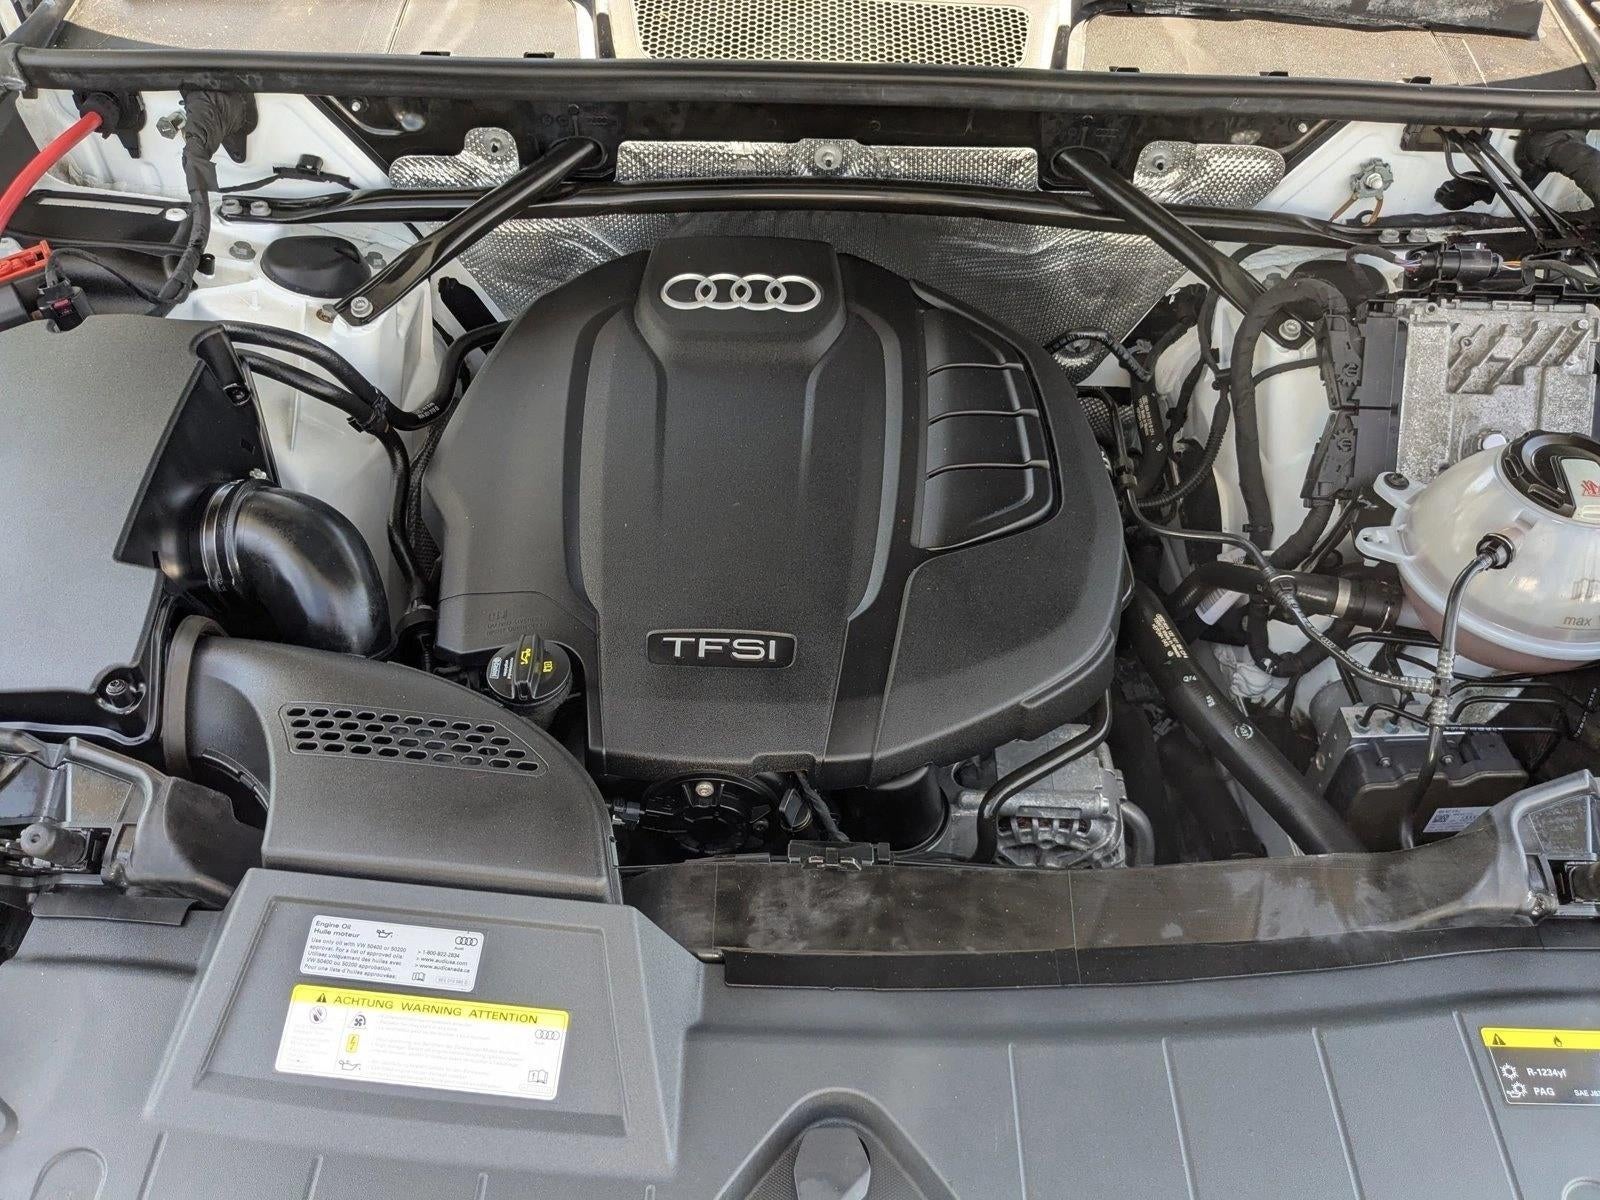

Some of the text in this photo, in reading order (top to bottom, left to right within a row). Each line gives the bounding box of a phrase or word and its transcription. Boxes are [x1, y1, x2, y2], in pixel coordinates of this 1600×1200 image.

[1562, 616, 1592, 626] max
[662, 637, 776, 660] TFSI
[315, 920, 352, 930] Engine Oil
[313, 927, 360, 938] Huile moteur
[367, 942, 383, 950] 50400
[390, 945, 407, 953] 50200
[328, 953, 360, 961] uniquement
[366, 950, 392, 958] approved
[420, 956, 468, 967] www.audiusa.com
[419, 964, 471, 974] www.audicanada.ca
[333, 995, 538, 1025] ACHTUNG WARNING ATTENTION
[1526, 1067, 1567, 1079] R-1234yf
[1533, 1087, 1556, 1096] PAG
[1573, 1089, 1589, 1097] SAE
